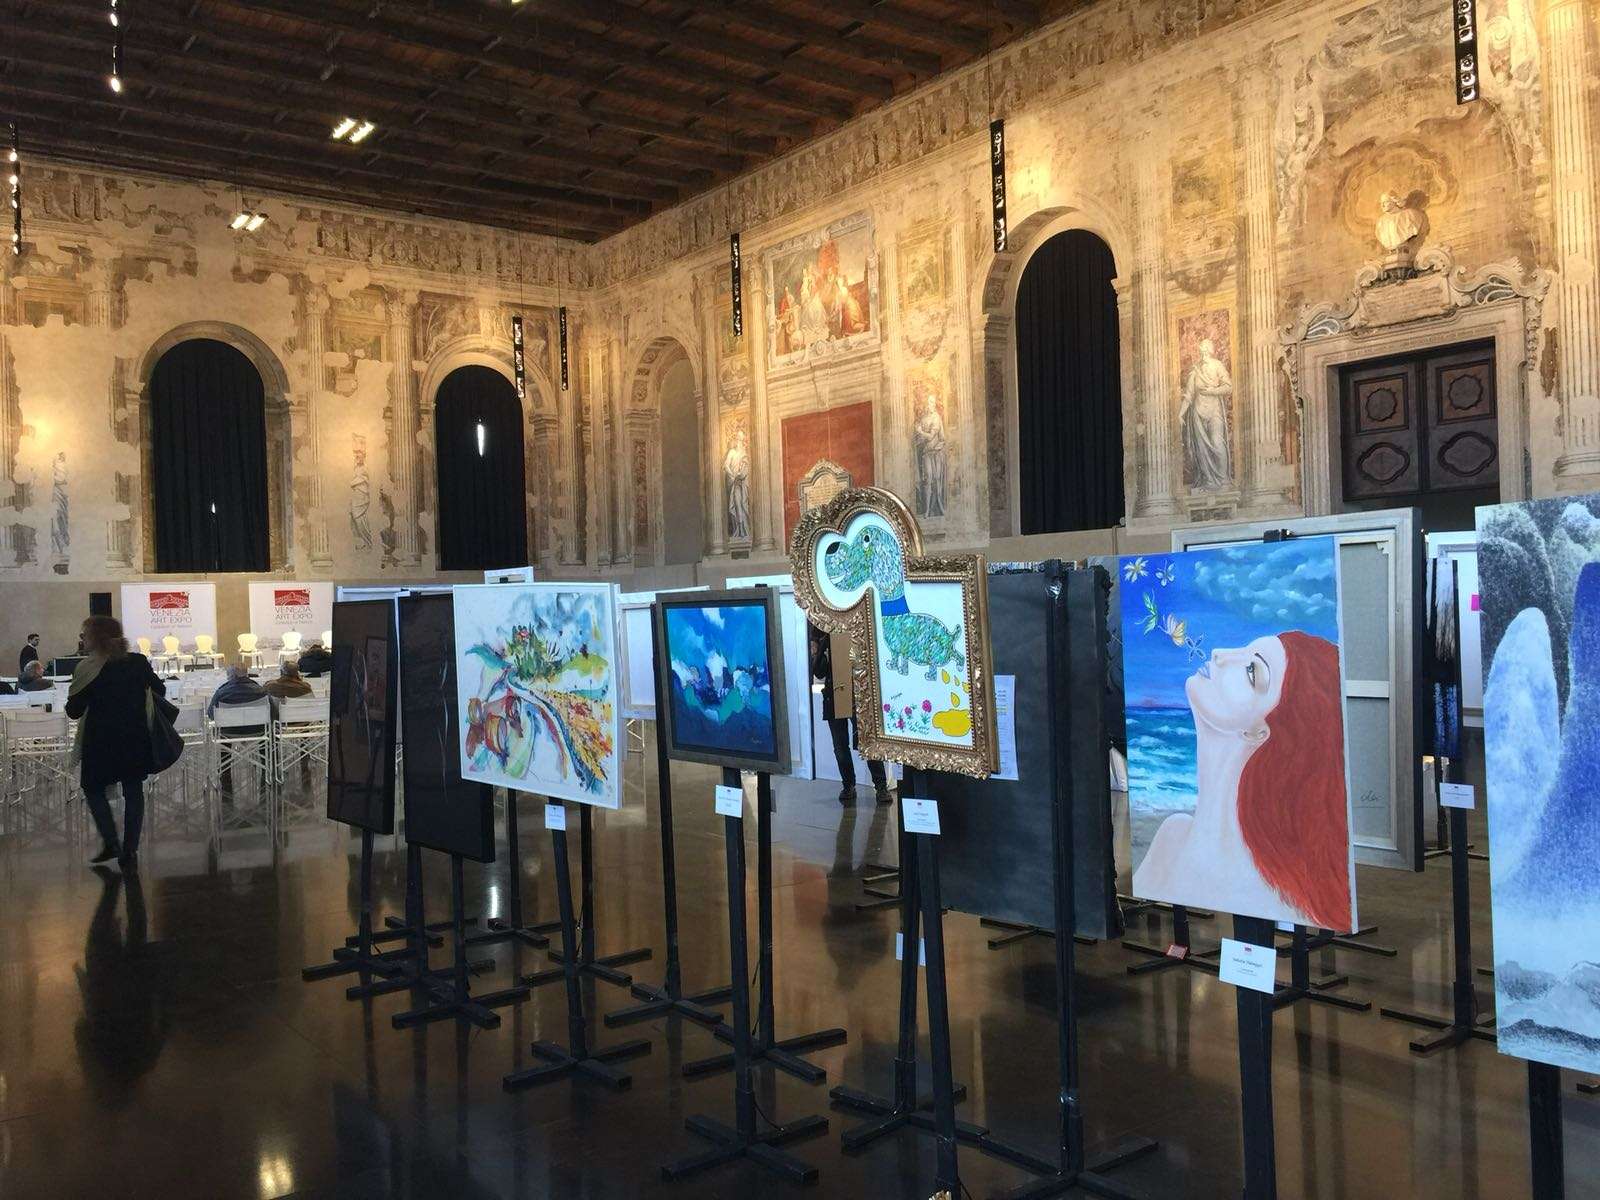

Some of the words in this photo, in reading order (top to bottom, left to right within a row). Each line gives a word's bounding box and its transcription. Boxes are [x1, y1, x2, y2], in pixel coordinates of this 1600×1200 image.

[150, 609, 191, 617] VENEZIA
[274, 606, 312, 614] VENEZIA
[150, 616, 167, 624] ART
[170, 616, 193, 624] EXPO
[275, 613, 290, 621] ART
[292, 613, 313, 621] EXPO
